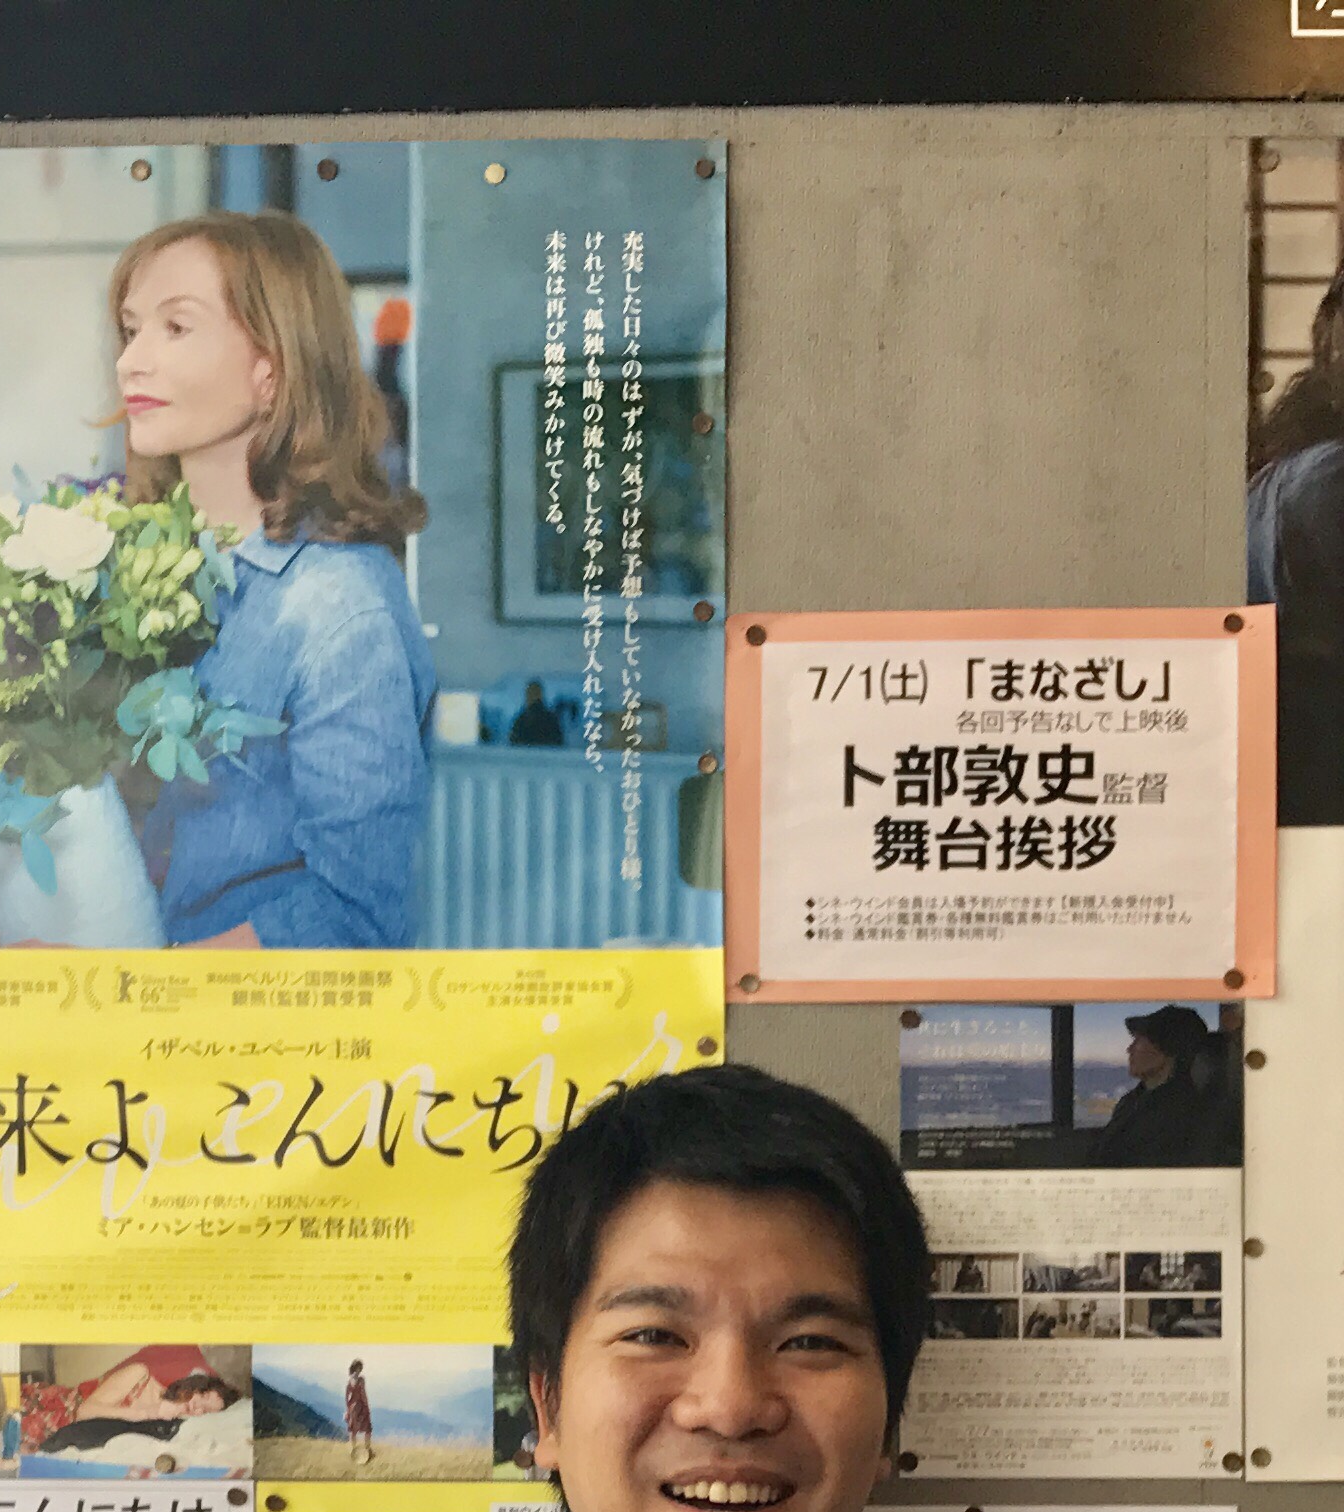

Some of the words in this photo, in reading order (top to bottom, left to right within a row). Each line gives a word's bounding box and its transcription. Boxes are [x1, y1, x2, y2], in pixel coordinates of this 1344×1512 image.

[806, 659, 930, 704] 7/1(土)
[962, 657, 1174, 702] 「まなざし」
[956, 709, 1190, 734] 各回予告なしで上映後
[871, 815, 1117, 872] 舞台挨拶
[140, 1036, 373, 1062] イザベル・ユペール主演
